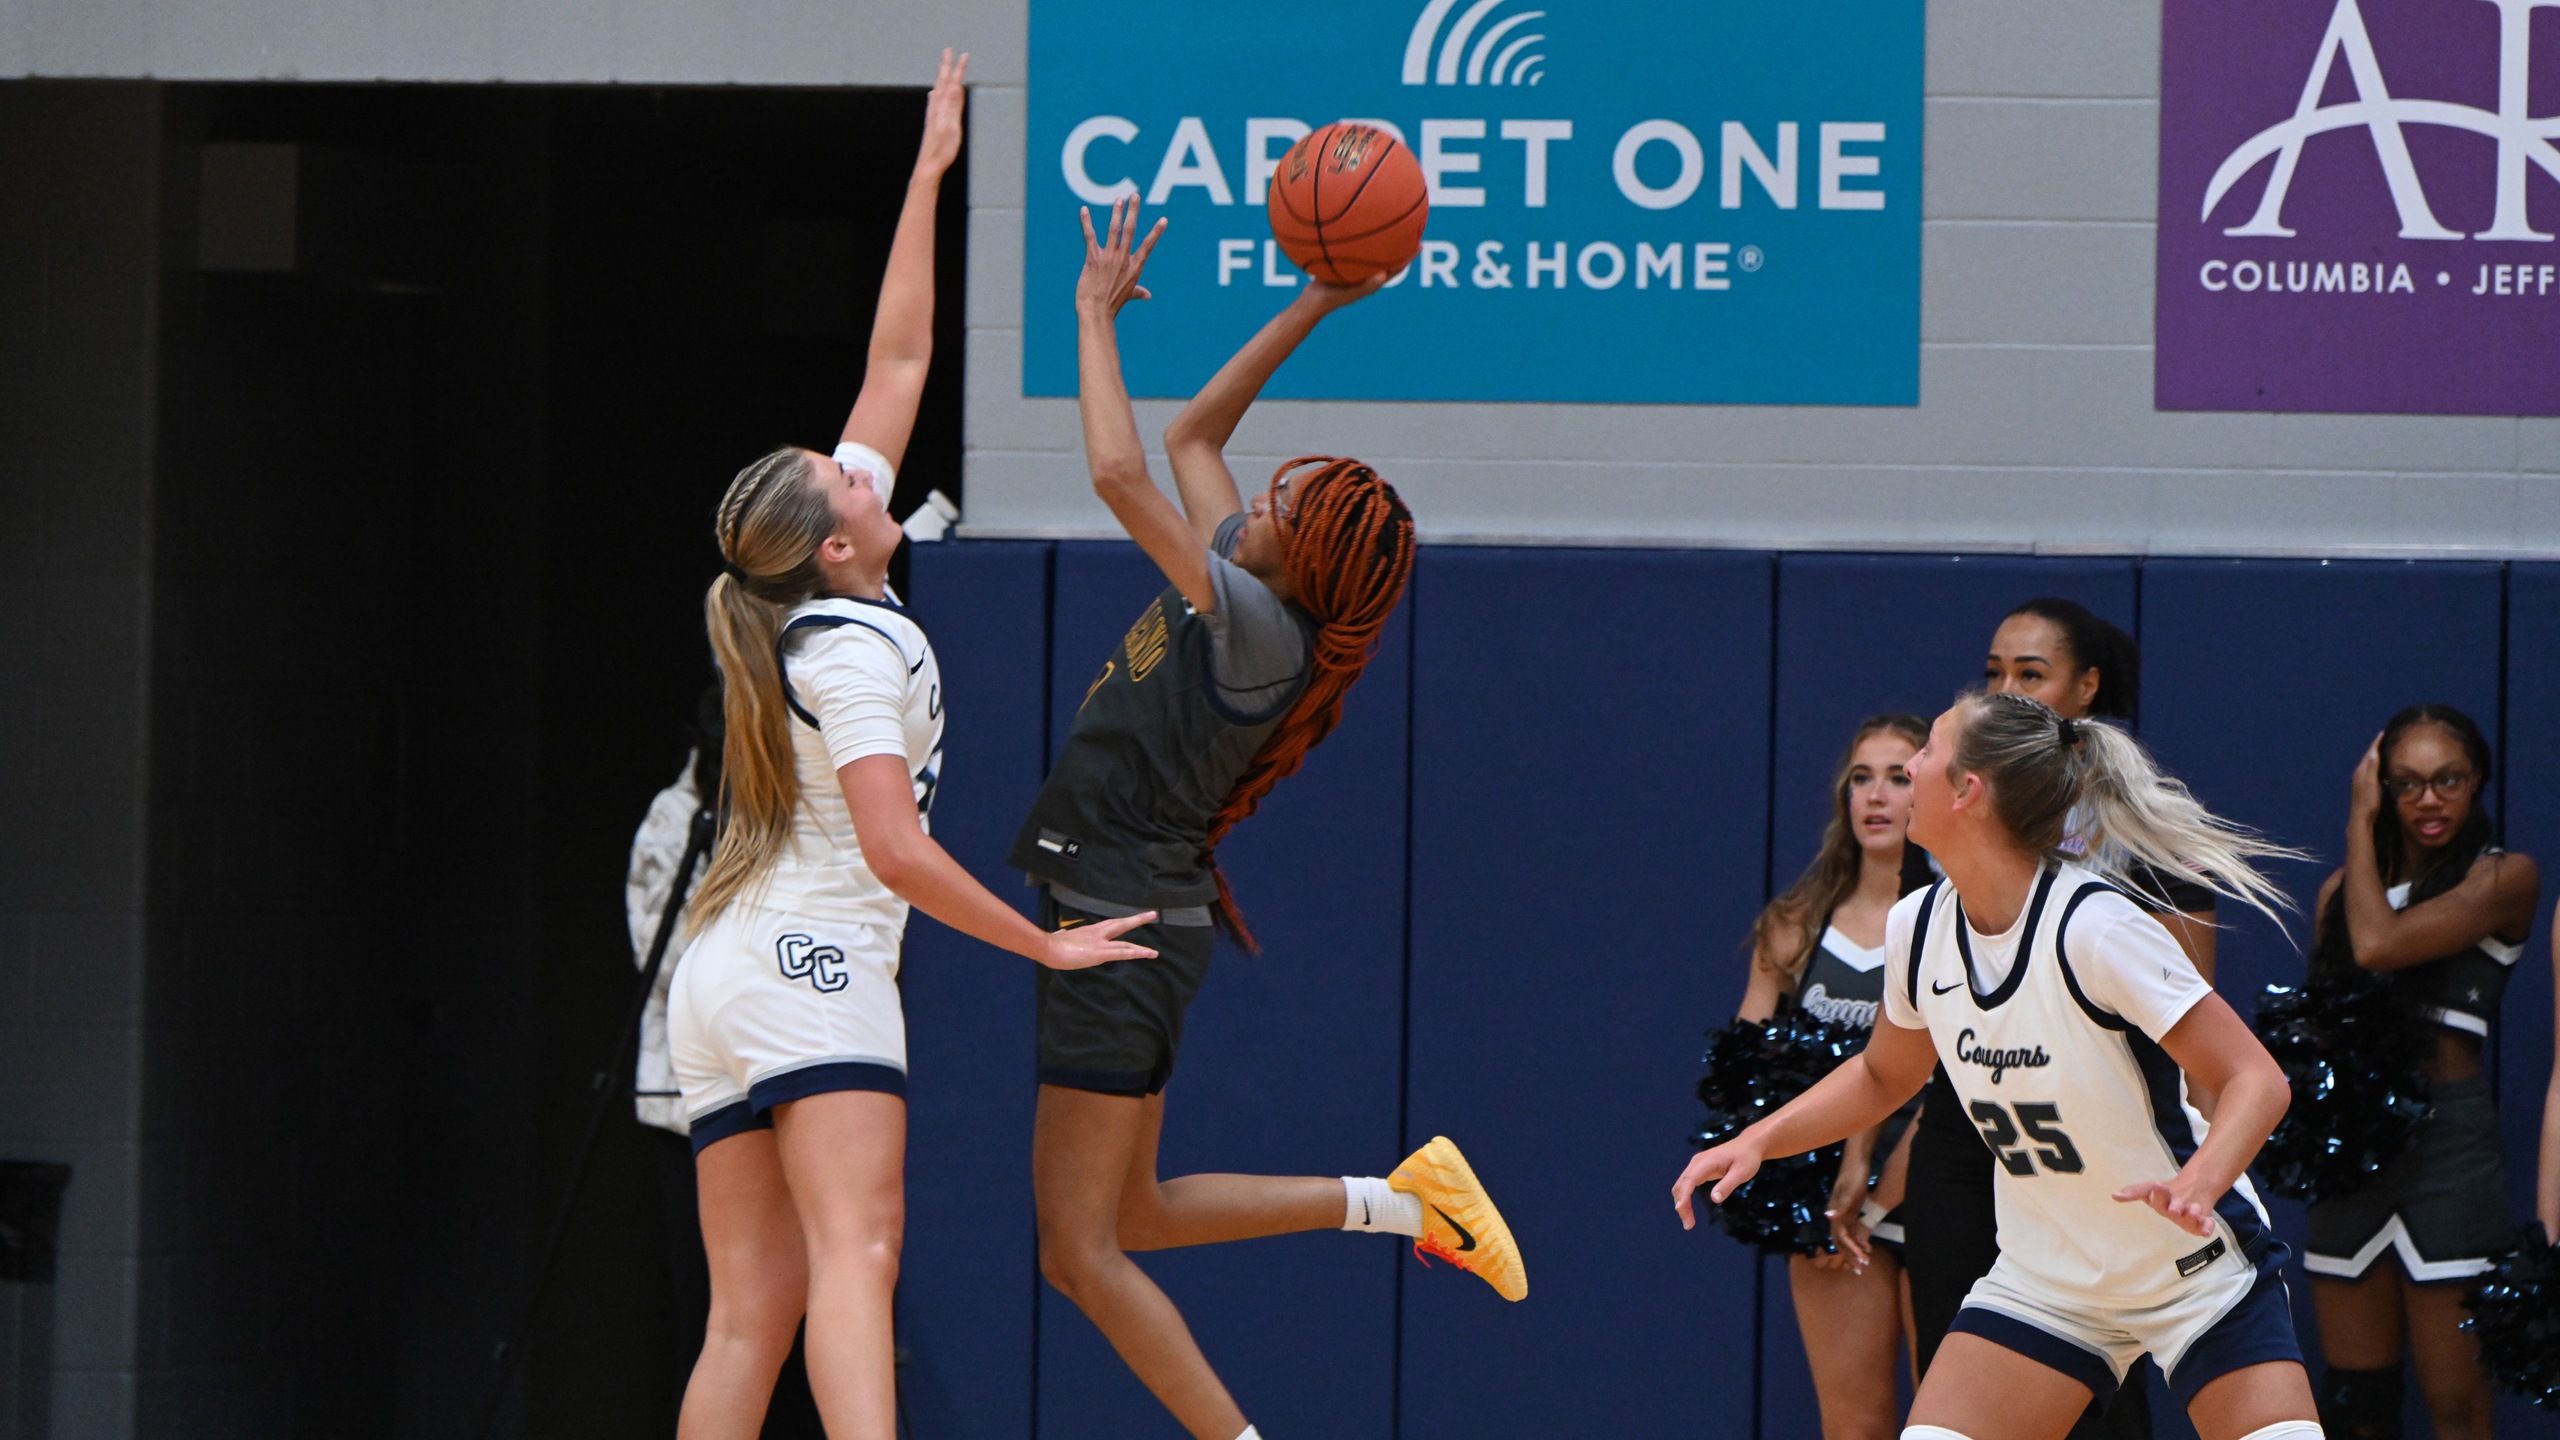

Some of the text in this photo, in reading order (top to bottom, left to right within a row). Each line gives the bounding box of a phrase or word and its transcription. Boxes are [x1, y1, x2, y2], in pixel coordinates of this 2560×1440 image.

[1061, 115, 1573, 208] CARET
[1612, 119, 1886, 210] ONE
[2200, 260, 2560, 296] COLUMBIA JEFF
[1956, 1028, 2051, 1084] Cougars
[1968, 1098, 2086, 1178] 25
